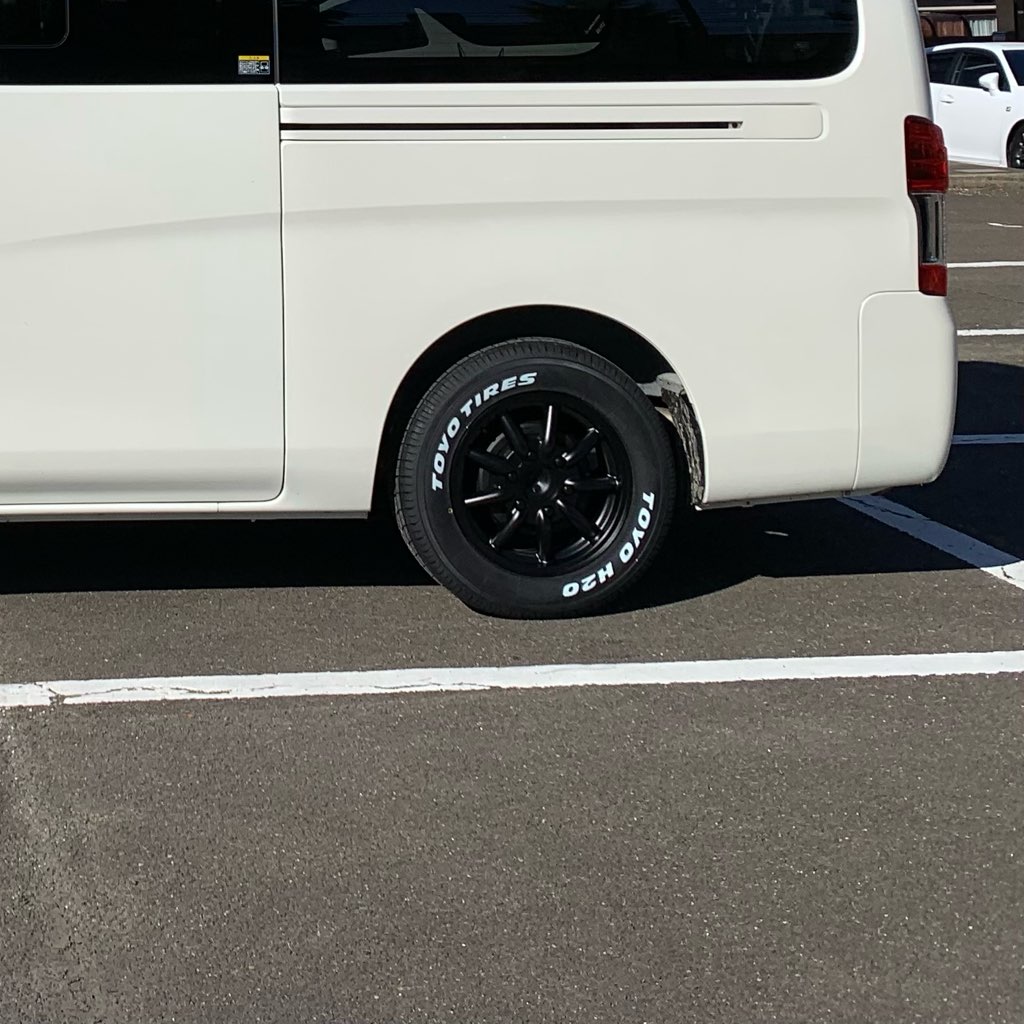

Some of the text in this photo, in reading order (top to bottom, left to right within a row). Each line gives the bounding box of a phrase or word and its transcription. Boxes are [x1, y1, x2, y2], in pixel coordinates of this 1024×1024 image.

[431, 371, 538, 491] TOYO TIRES
[618, 491, 655, 564] TOYO
